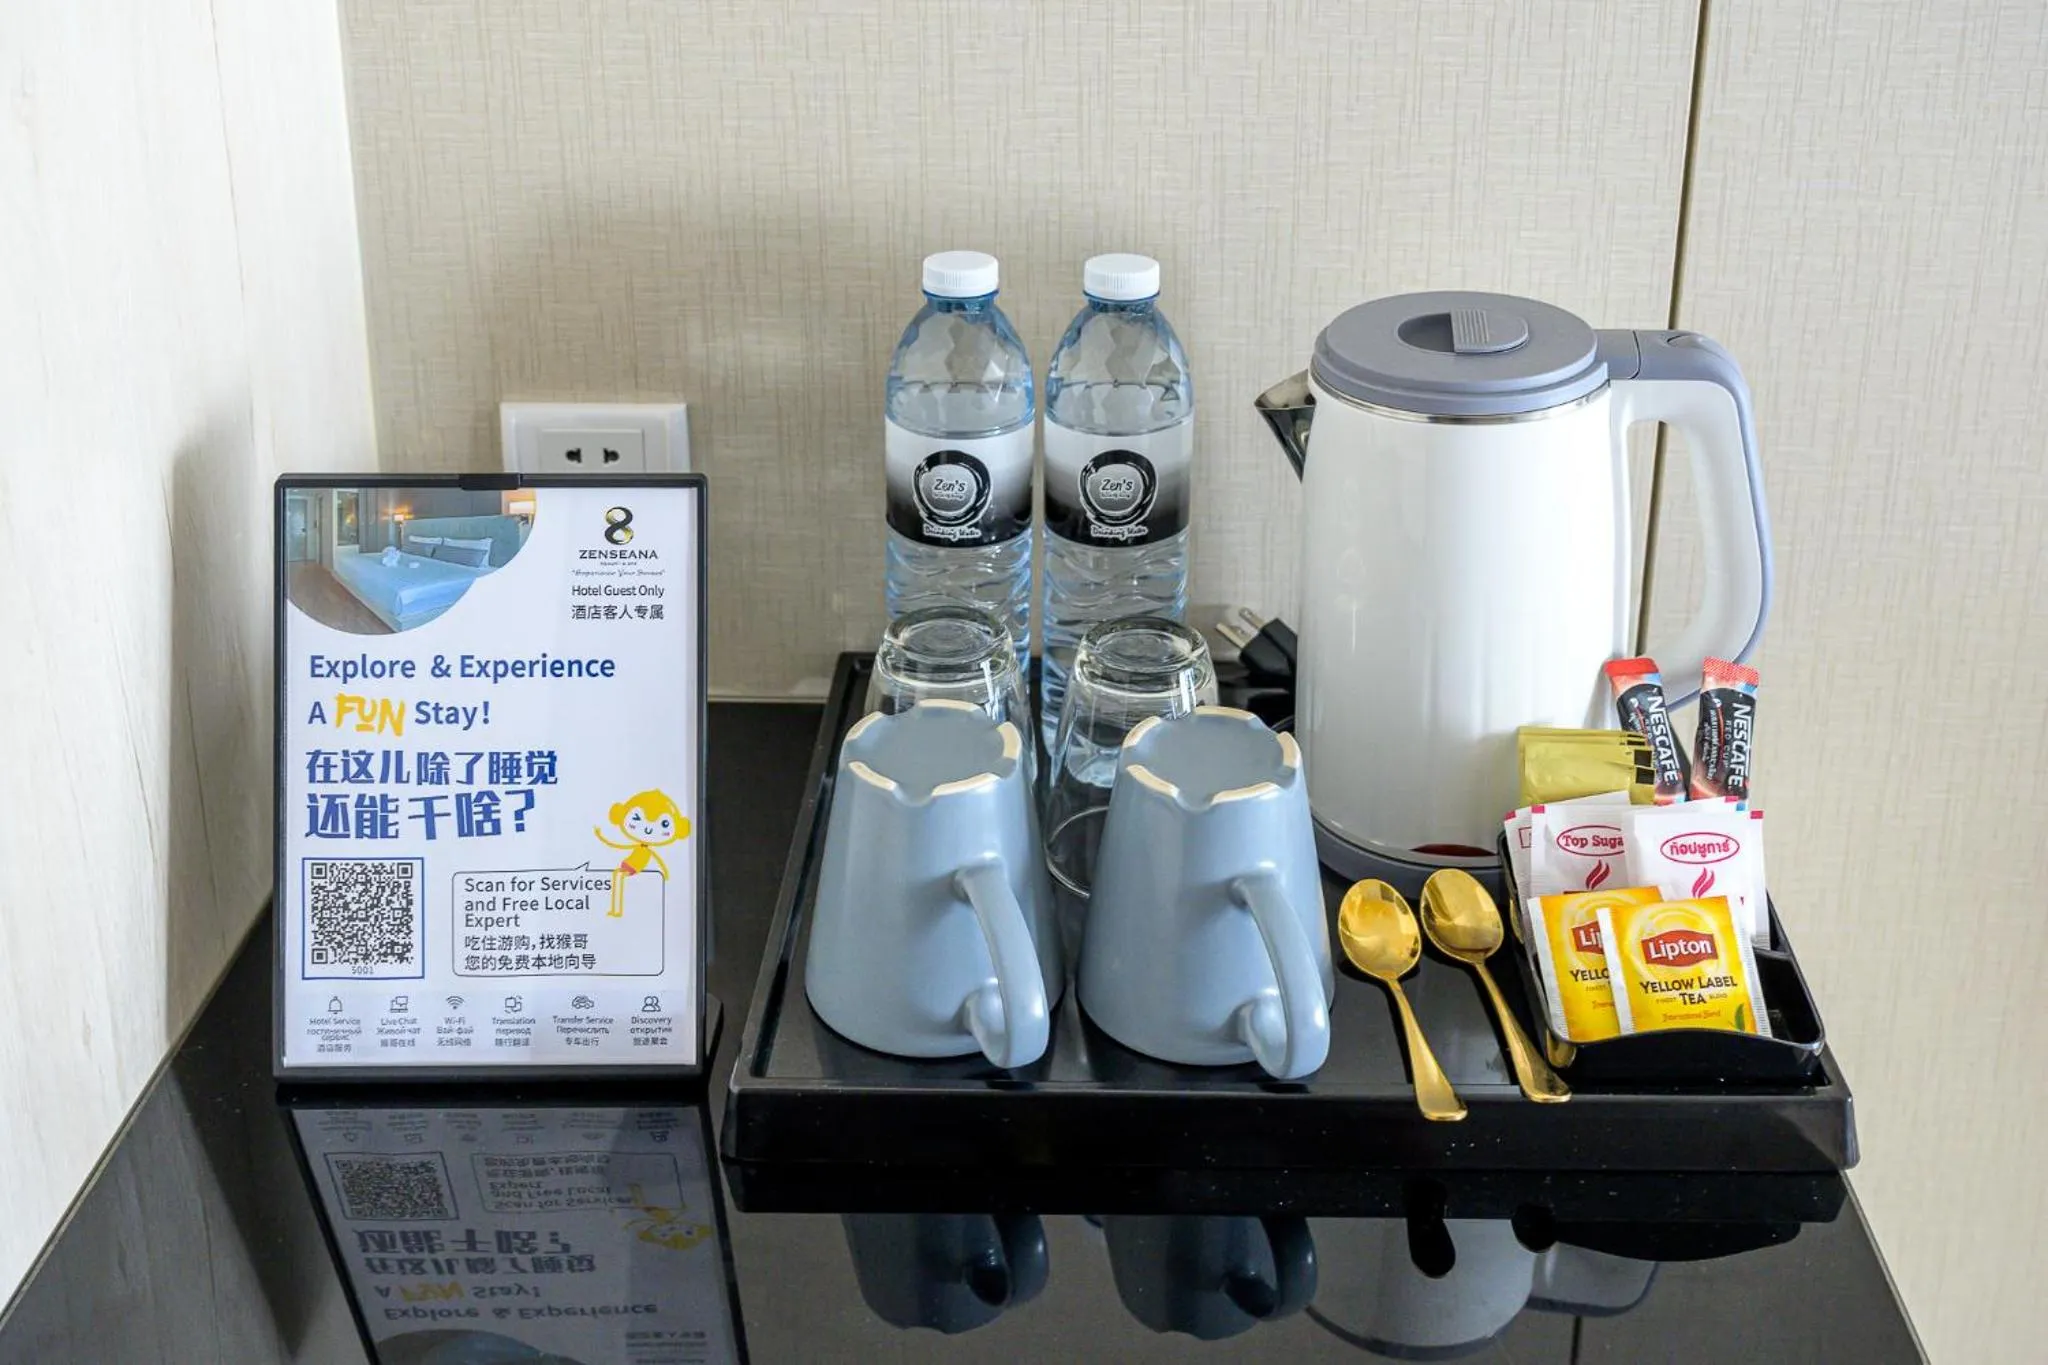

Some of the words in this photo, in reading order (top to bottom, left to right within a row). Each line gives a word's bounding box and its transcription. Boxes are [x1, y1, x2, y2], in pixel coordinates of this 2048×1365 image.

[933, 479, 966, 492] Zen's
[1101, 479, 1133, 492] Zen's
[579, 549, 658, 559] ZENSEANA
[572, 585, 602, 596] Hotel
[604, 585, 637, 596] Guest
[639, 585, 665, 598] Only
[572, 604, 664, 620] 酒店客人专属
[310, 653, 415, 684] Explore
[431, 654, 452, 678] &
[460, 654, 616, 684] Experience
[308, 701, 327, 724] A
[335, 693, 406, 737] FUN
[414, 700, 490, 731] Stay!
[306, 749, 558, 785] 在这儿除了睡觉
[304, 789, 535, 840] 还能干啥？
[1562, 835, 1589, 850] Top
[1591, 834, 1624, 850] Suga
[464, 877, 505, 892] Scan
[511, 876, 536, 892] for
[541, 876, 612, 891] Services
[464, 896, 497, 911] and
[503, 897, 539, 911] Free
[545, 895, 590, 910] Local
[465, 913, 520, 931] Expert
[1648, 938, 1713, 961] Lipton
[464, 953, 597, 971] 您的免费本地向导
[1570, 967, 1610, 982] YELLO
[1640, 977, 1695, 994] YELLOW
[1698, 976, 1738, 990] LABEL
[1679, 992, 1708, 1006] TEA
[444, 1016, 466, 1025] Wi-Fi
[492, 1017, 536, 1025] Translation
[631, 1016, 672, 1026] Discovery
